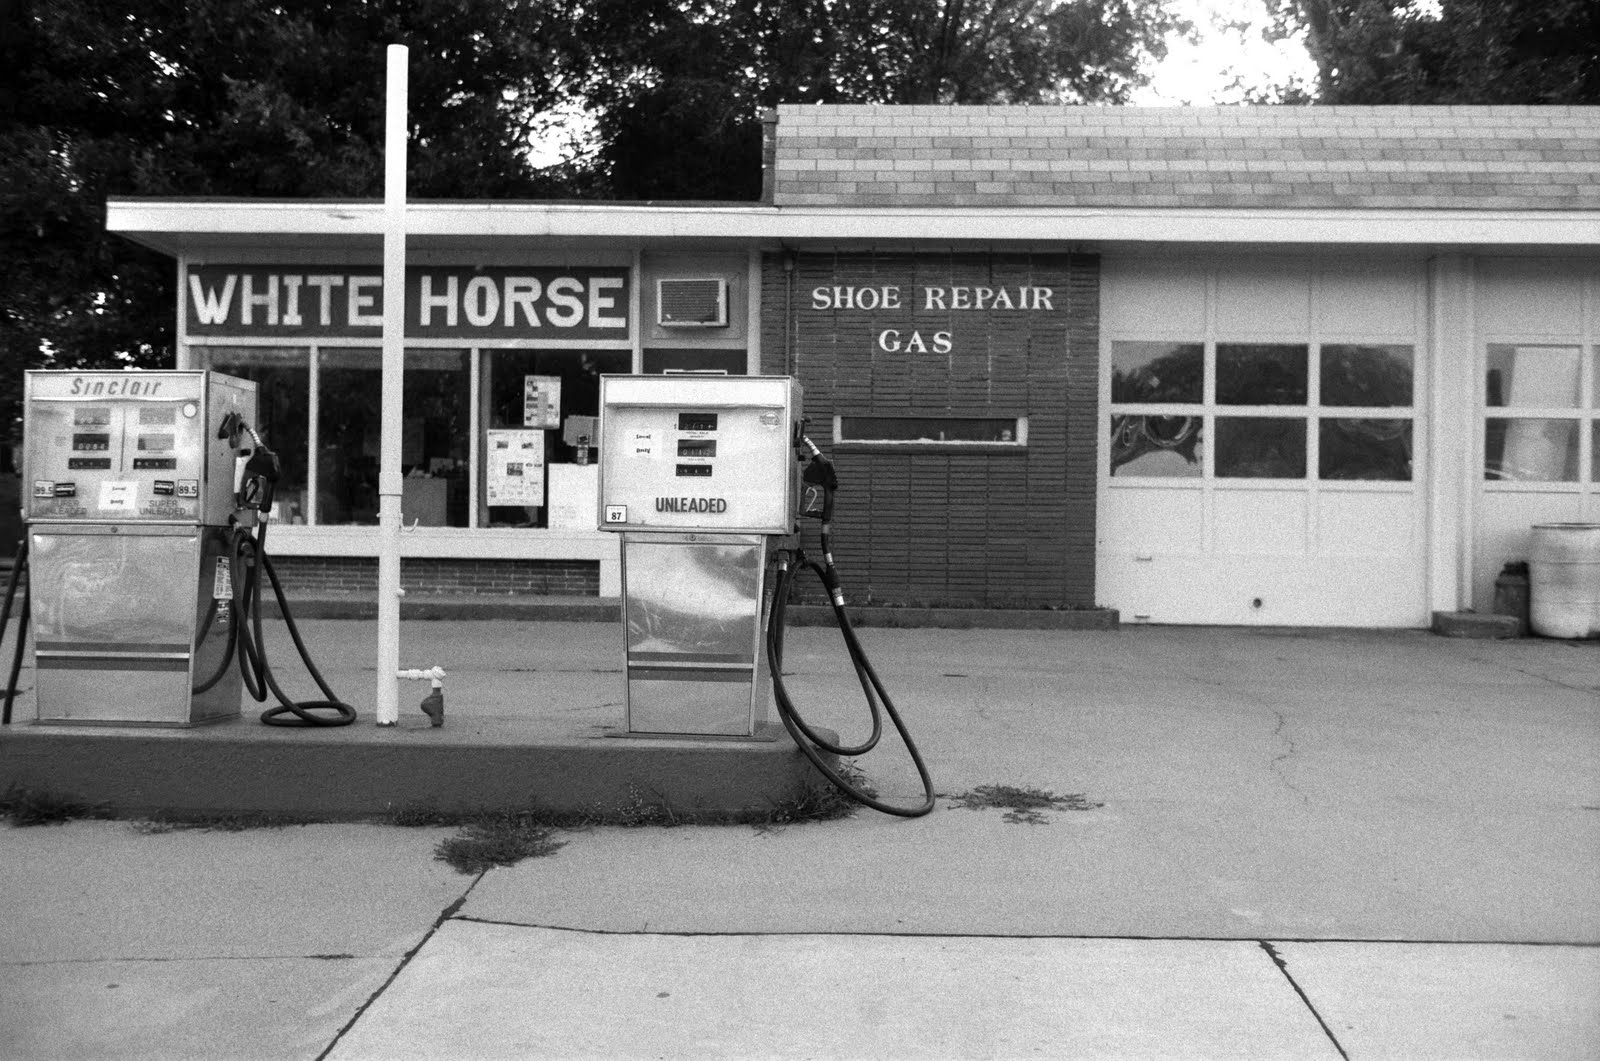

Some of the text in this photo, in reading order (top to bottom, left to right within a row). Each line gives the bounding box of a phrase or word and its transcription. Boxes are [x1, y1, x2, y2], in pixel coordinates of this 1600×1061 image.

[188, 274, 626, 328] WHITE HORSE
[812, 286, 1054, 310] SHOE REPAIR
[878, 329, 952, 354] GAS
[71, 377, 162, 395] Sinclair
[178, 485, 197, 494] 89.5
[149, 499, 178, 507] SUPER
[655, 497, 727, 513] UNLEADED
[805, 486, 818, 513] 2
[139, 507, 187, 515] UNLEADED
[611, 512, 622, 520] 87
